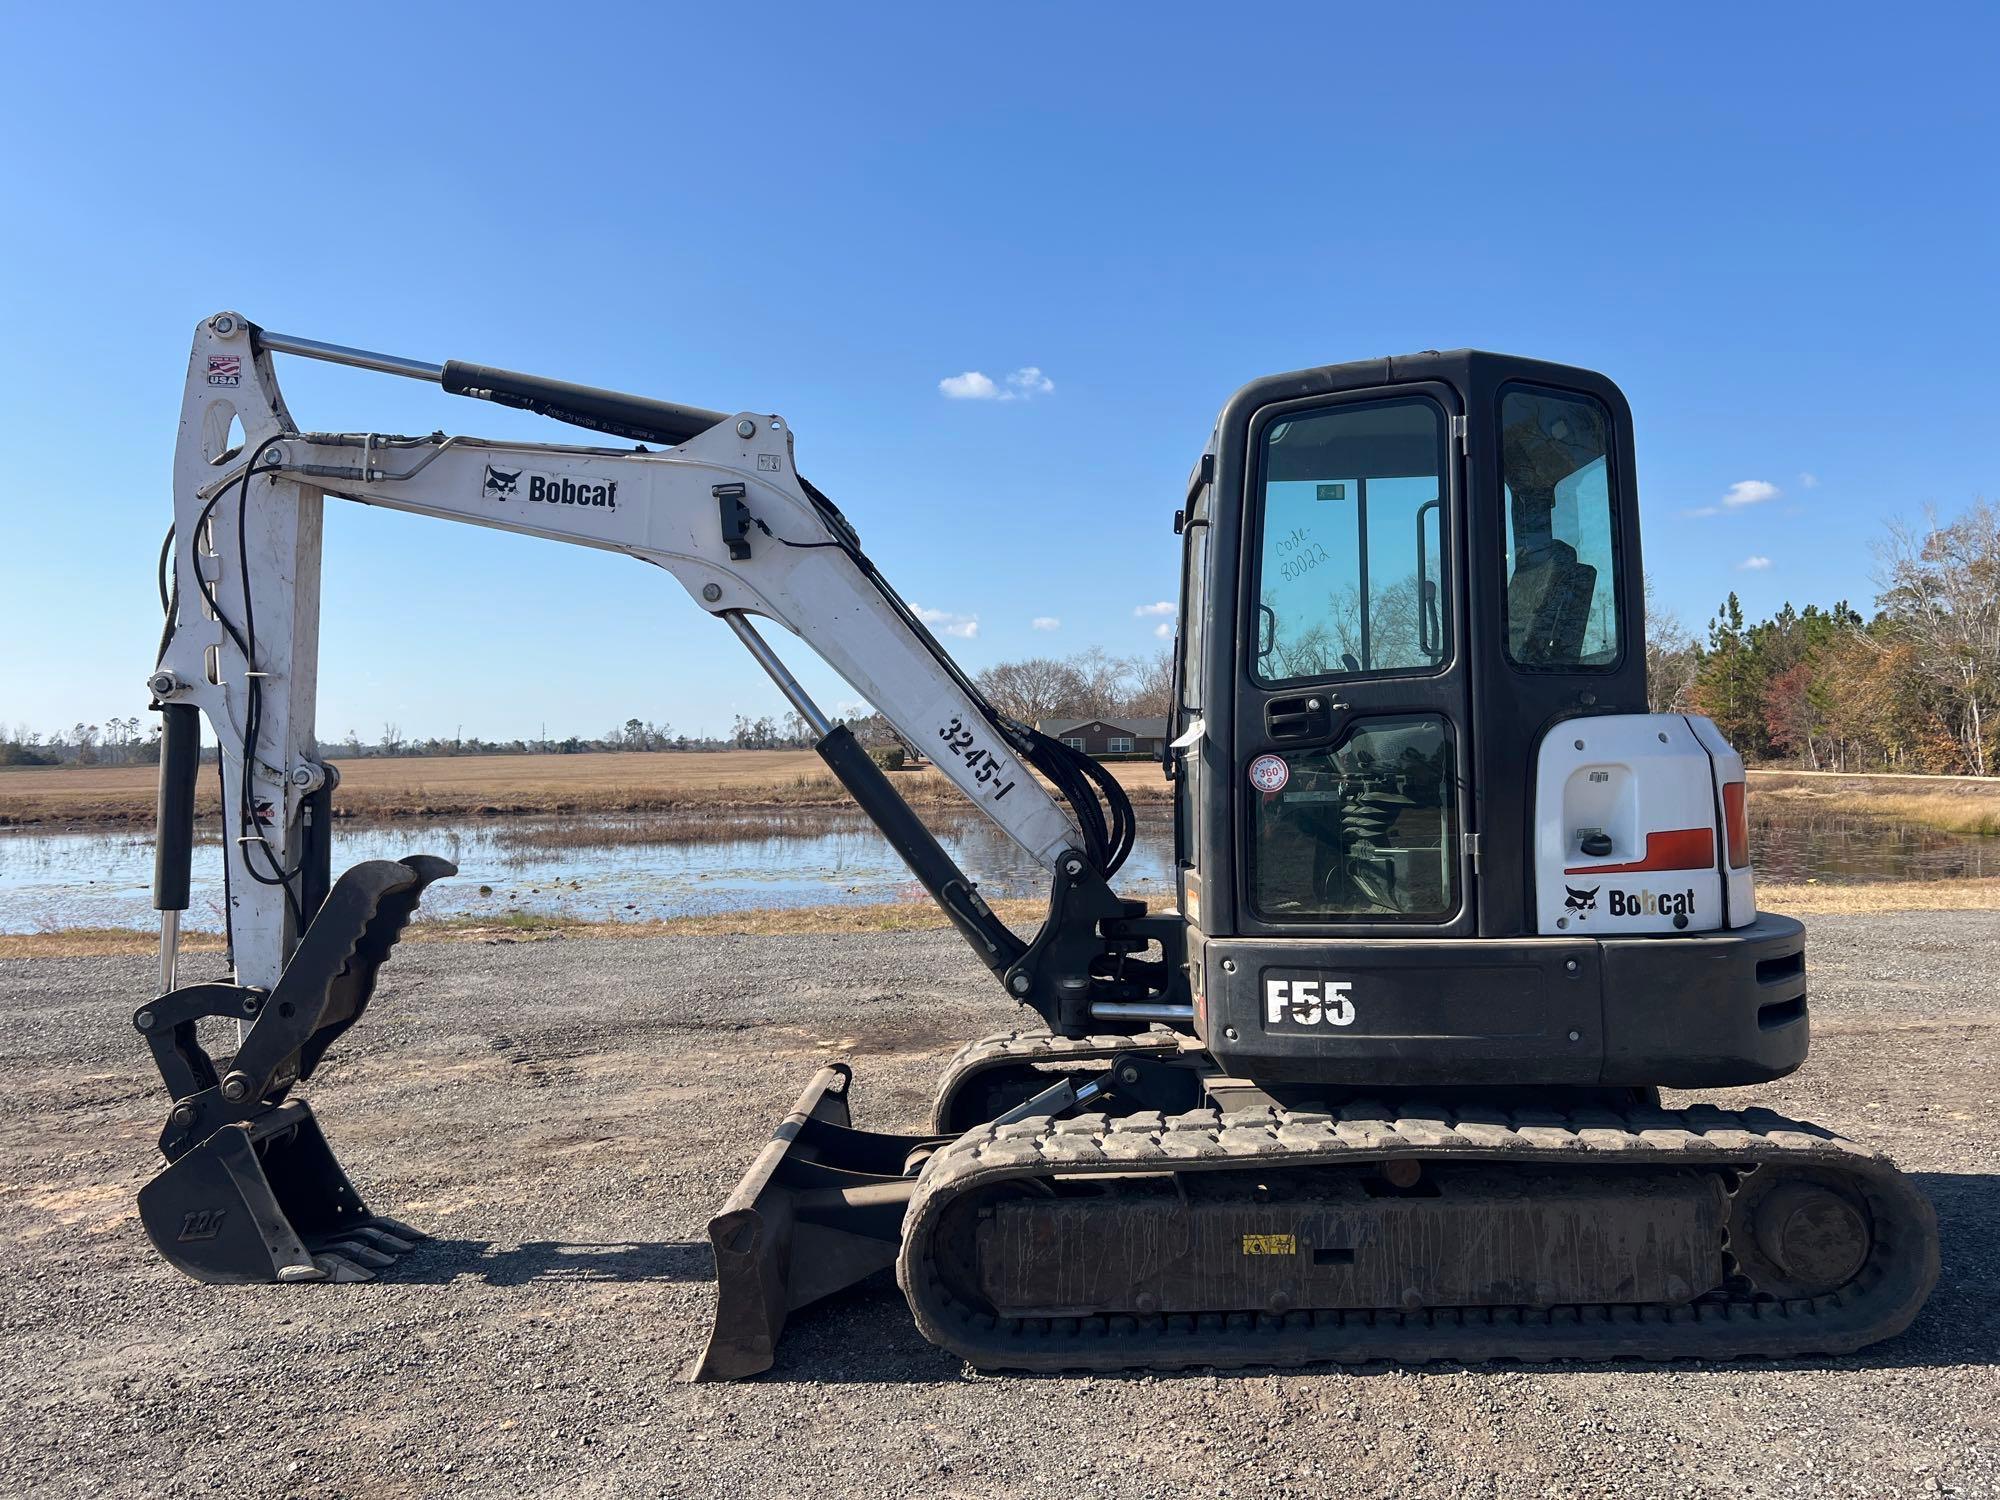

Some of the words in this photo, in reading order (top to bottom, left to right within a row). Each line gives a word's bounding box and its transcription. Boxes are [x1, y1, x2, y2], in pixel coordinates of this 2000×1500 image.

[210, 376, 237, 385] USA
[529, 476, 616, 507] Bobcat
[1281, 543, 1331, 581] 80022
[939, 718, 1015, 800] 3245-1
[1259, 767, 1279, 778] 360
[1609, 889, 1695, 916] Bobcat
[1267, 980, 1355, 1026] F55
